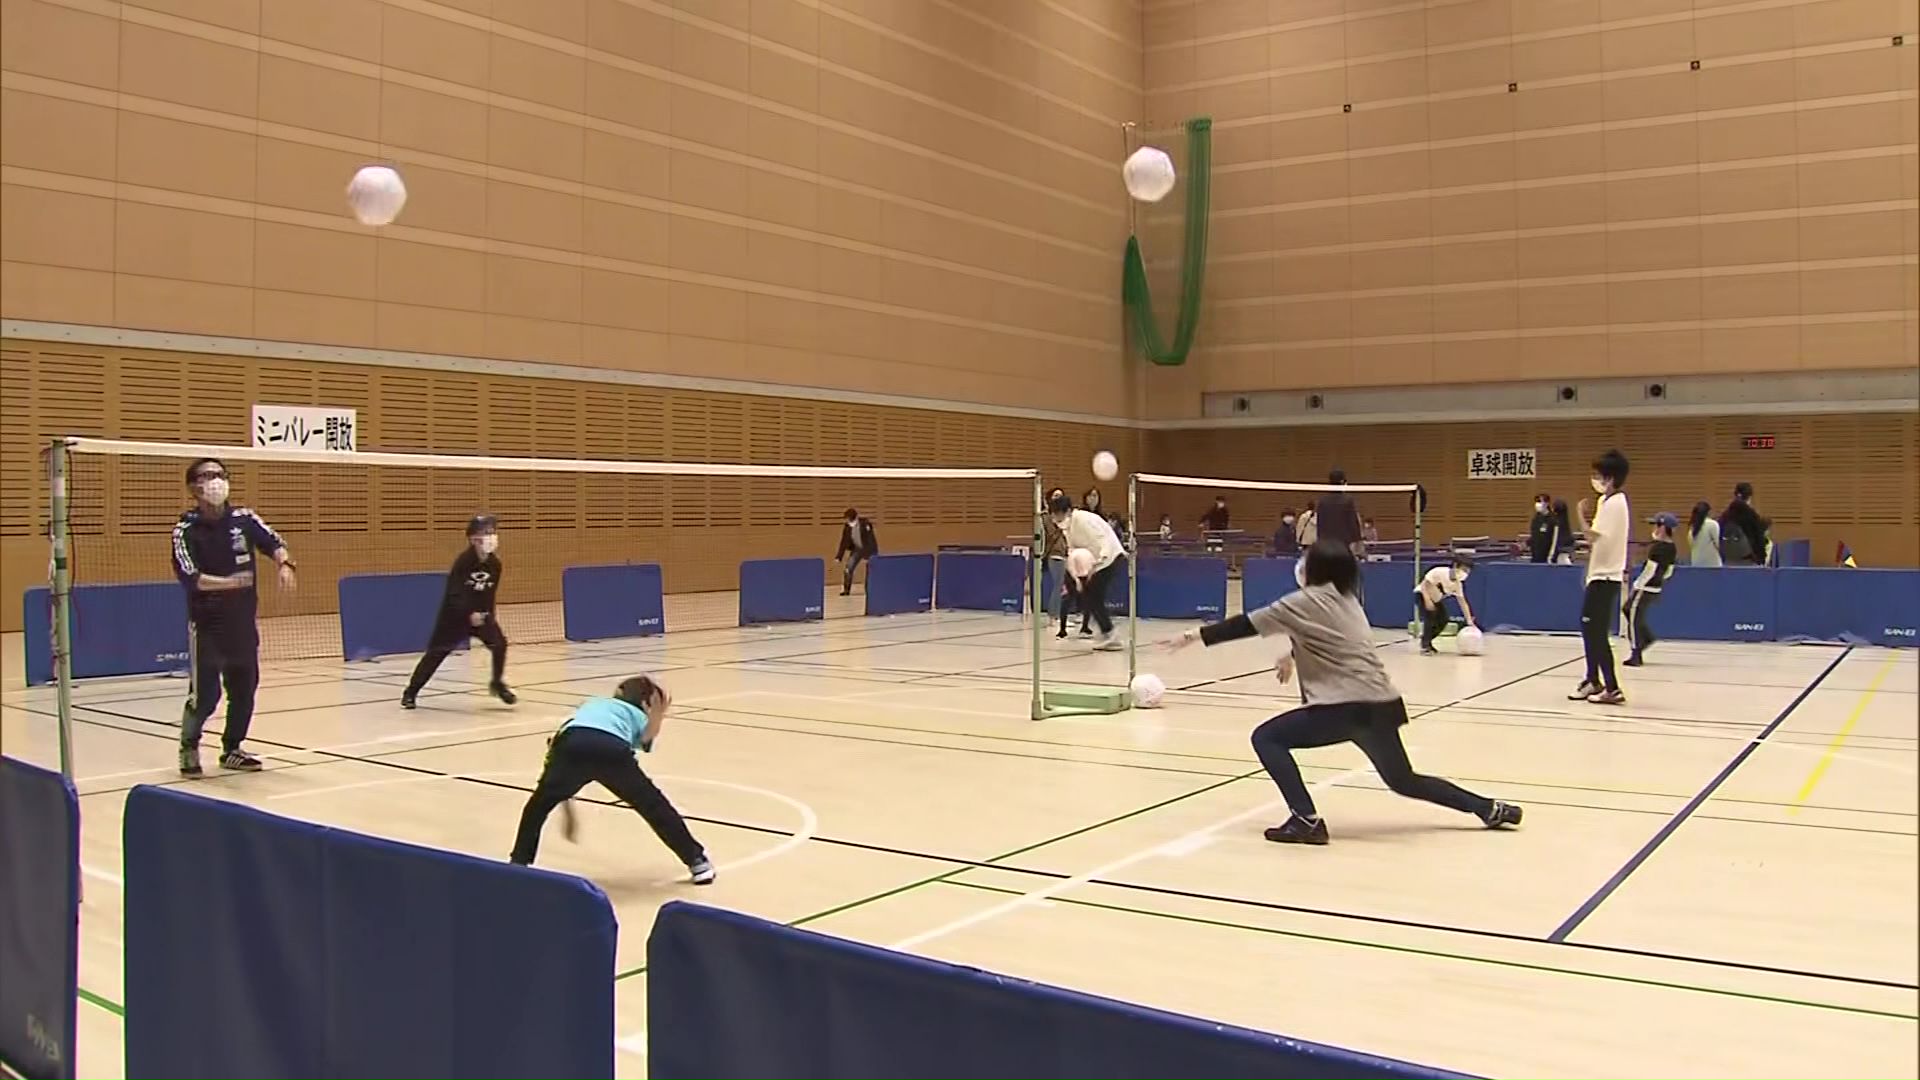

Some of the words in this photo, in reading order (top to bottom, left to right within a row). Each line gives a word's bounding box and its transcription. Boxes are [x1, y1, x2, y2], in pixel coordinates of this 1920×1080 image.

[257, 415, 353, 451] ミニバレー開放
[1470, 451, 1534, 476] 卓球開放
